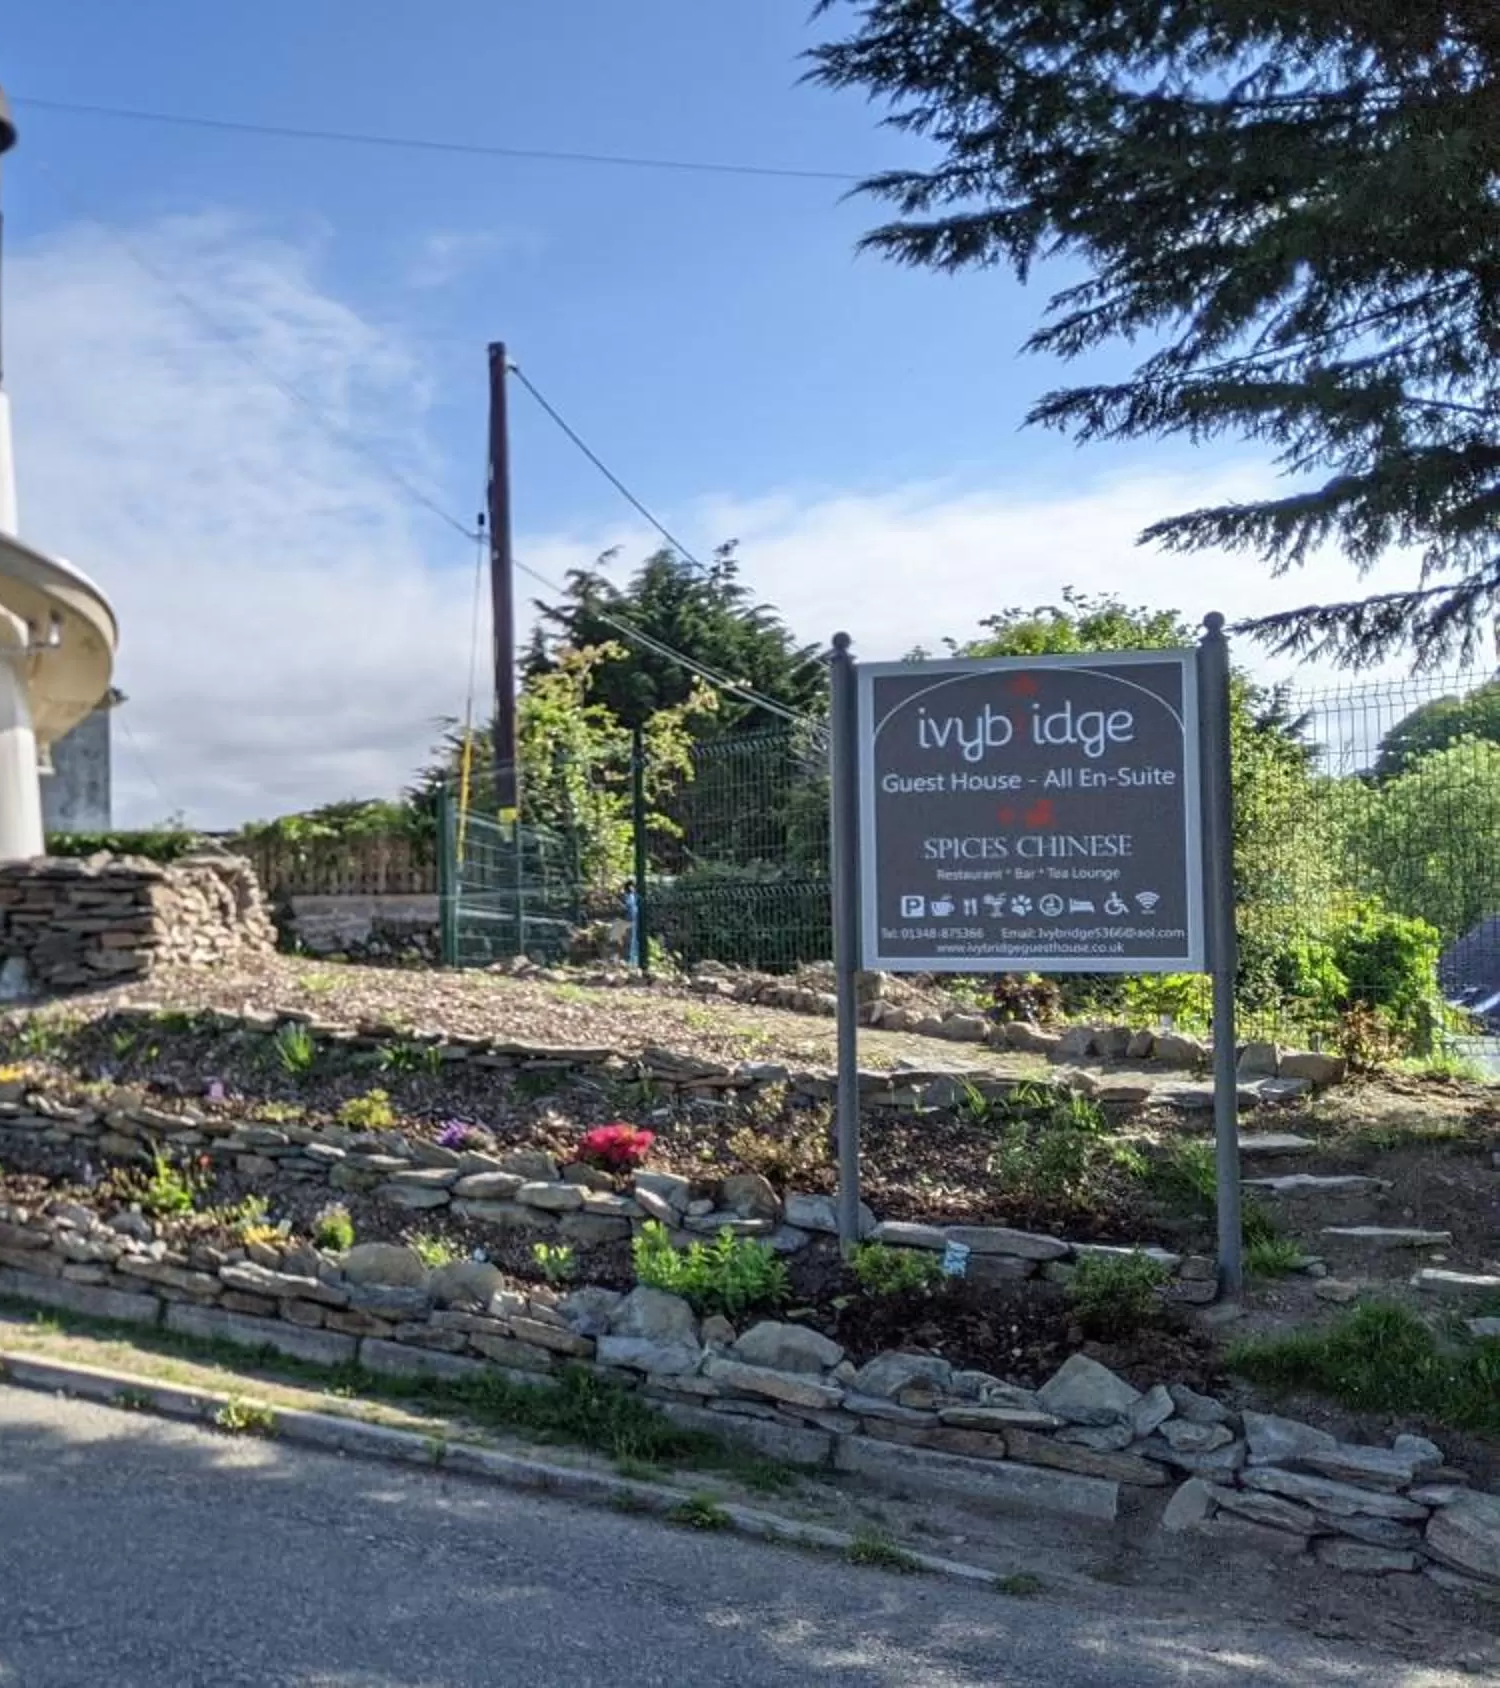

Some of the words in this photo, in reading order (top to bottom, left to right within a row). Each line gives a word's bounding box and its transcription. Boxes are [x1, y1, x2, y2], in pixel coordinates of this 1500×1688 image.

[881, 772, 946, 793] Guest
[951, 771, 1022, 791] House
[1043, 768, 1074, 788] All
[1079, 766, 1177, 788] En-Suite
[923, 836, 1008, 859] SPICES
[1016, 835, 1133, 858] CHINESE
[936, 869, 1003, 881] Restaurant
[1015, 867, 1035, 879] Bar
[1047, 867, 1069, 879] Tea
[1072, 867, 1121, 881] Lounge
